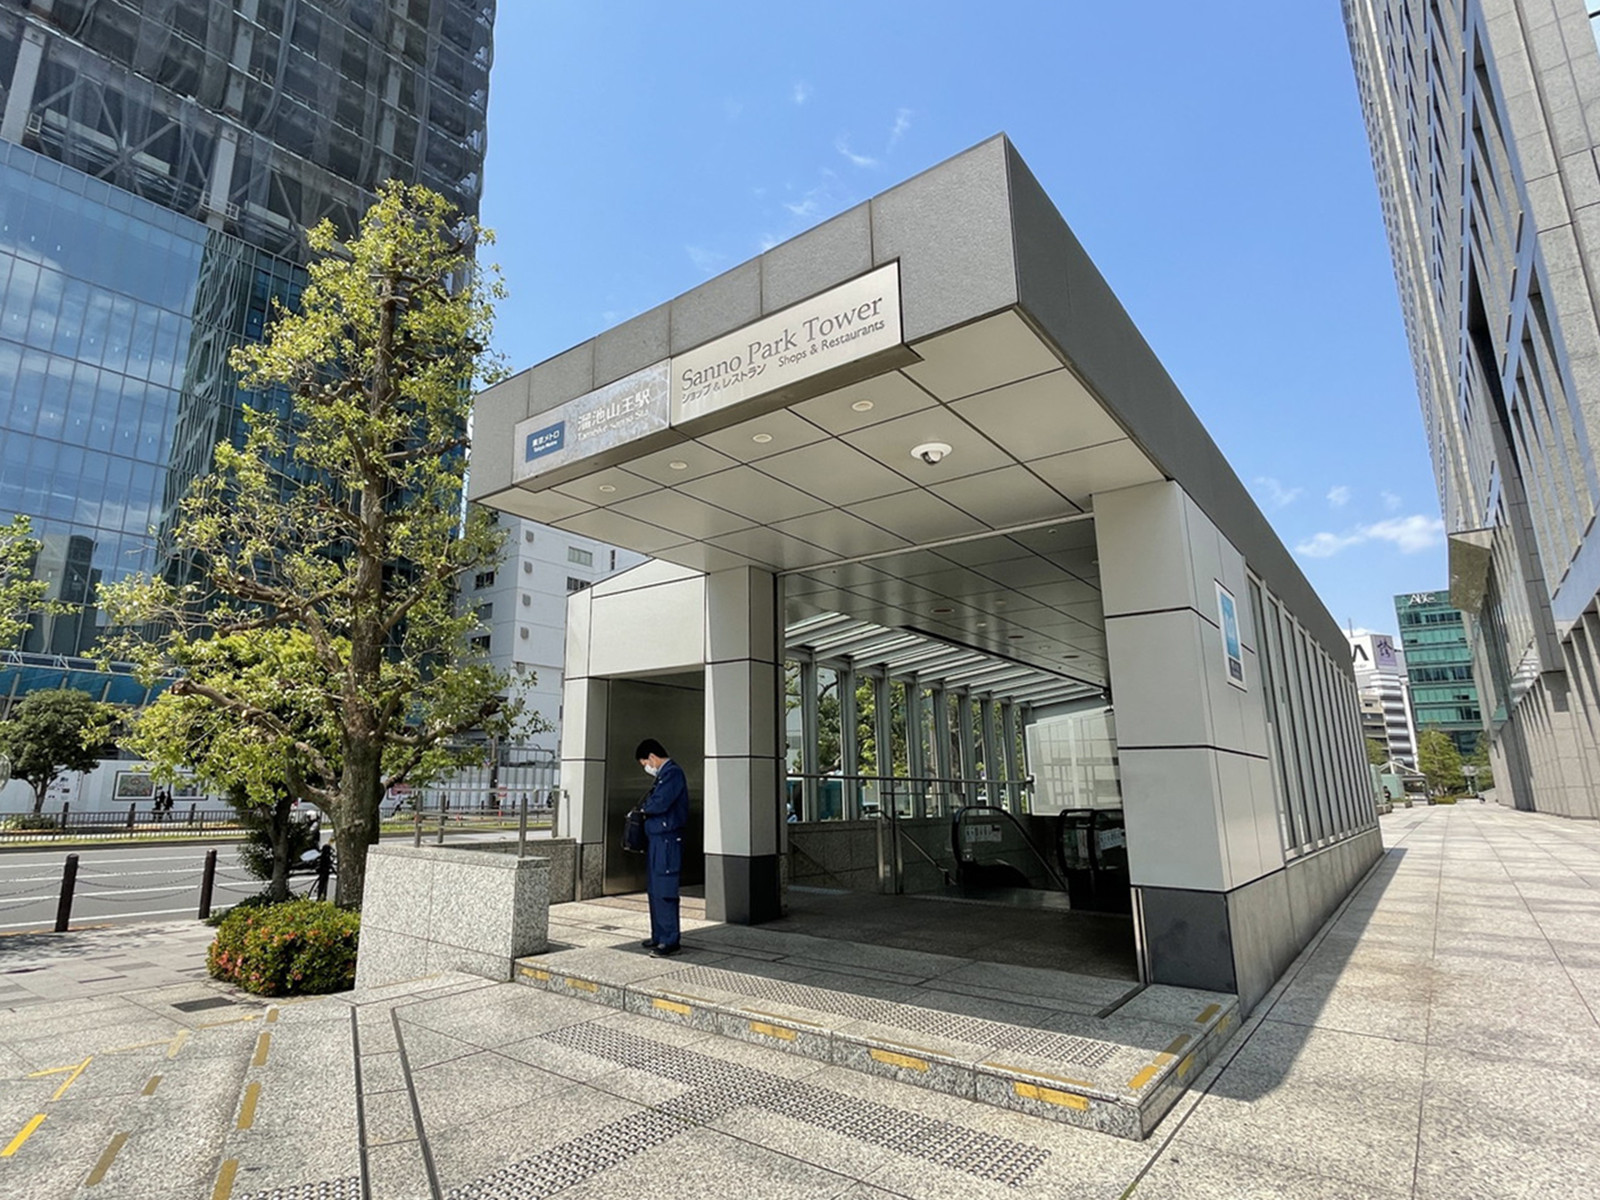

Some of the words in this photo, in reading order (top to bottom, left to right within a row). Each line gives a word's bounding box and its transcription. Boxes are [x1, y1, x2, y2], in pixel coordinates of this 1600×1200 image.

[682, 356, 742, 391] Sanno
[748, 328, 798, 366] Park
[802, 297, 883, 342] Tower
[778, 350, 807, 368] Shops
[810, 343, 819, 355] &
[821, 320, 885, 350] Restaurants
